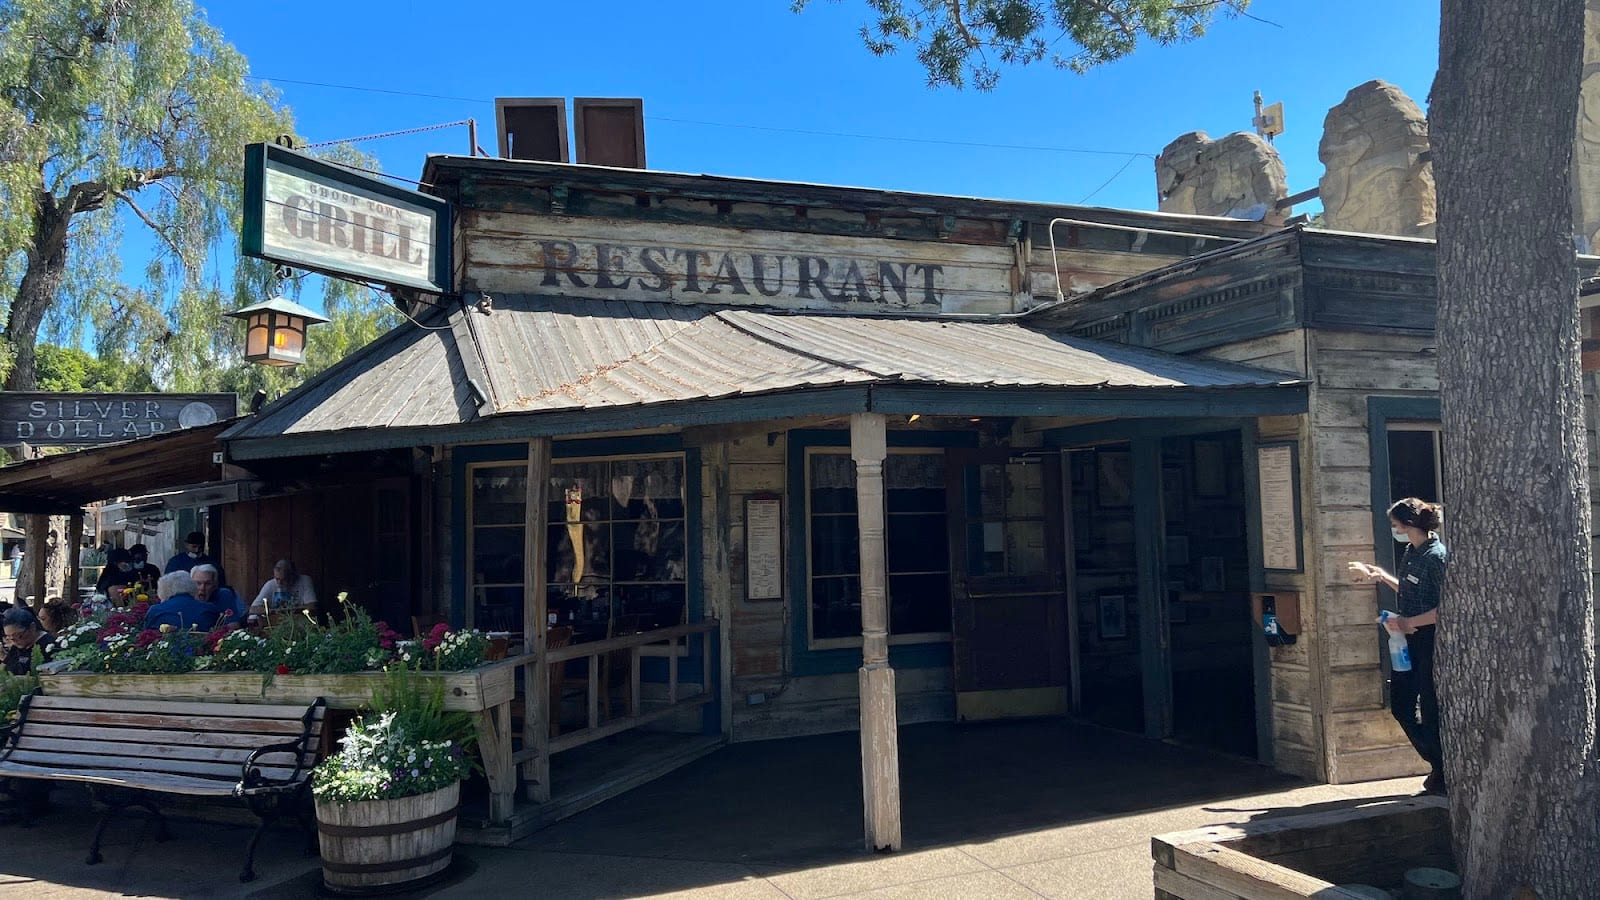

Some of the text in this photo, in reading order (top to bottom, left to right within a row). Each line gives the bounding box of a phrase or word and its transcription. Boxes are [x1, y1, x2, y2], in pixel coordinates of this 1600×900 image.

[309, 182, 402, 218] GHOST TOWN
[282, 195, 423, 265] GRILL
[537, 239, 944, 305] RESTAURANT
[28, 401, 161, 419] SILVER
